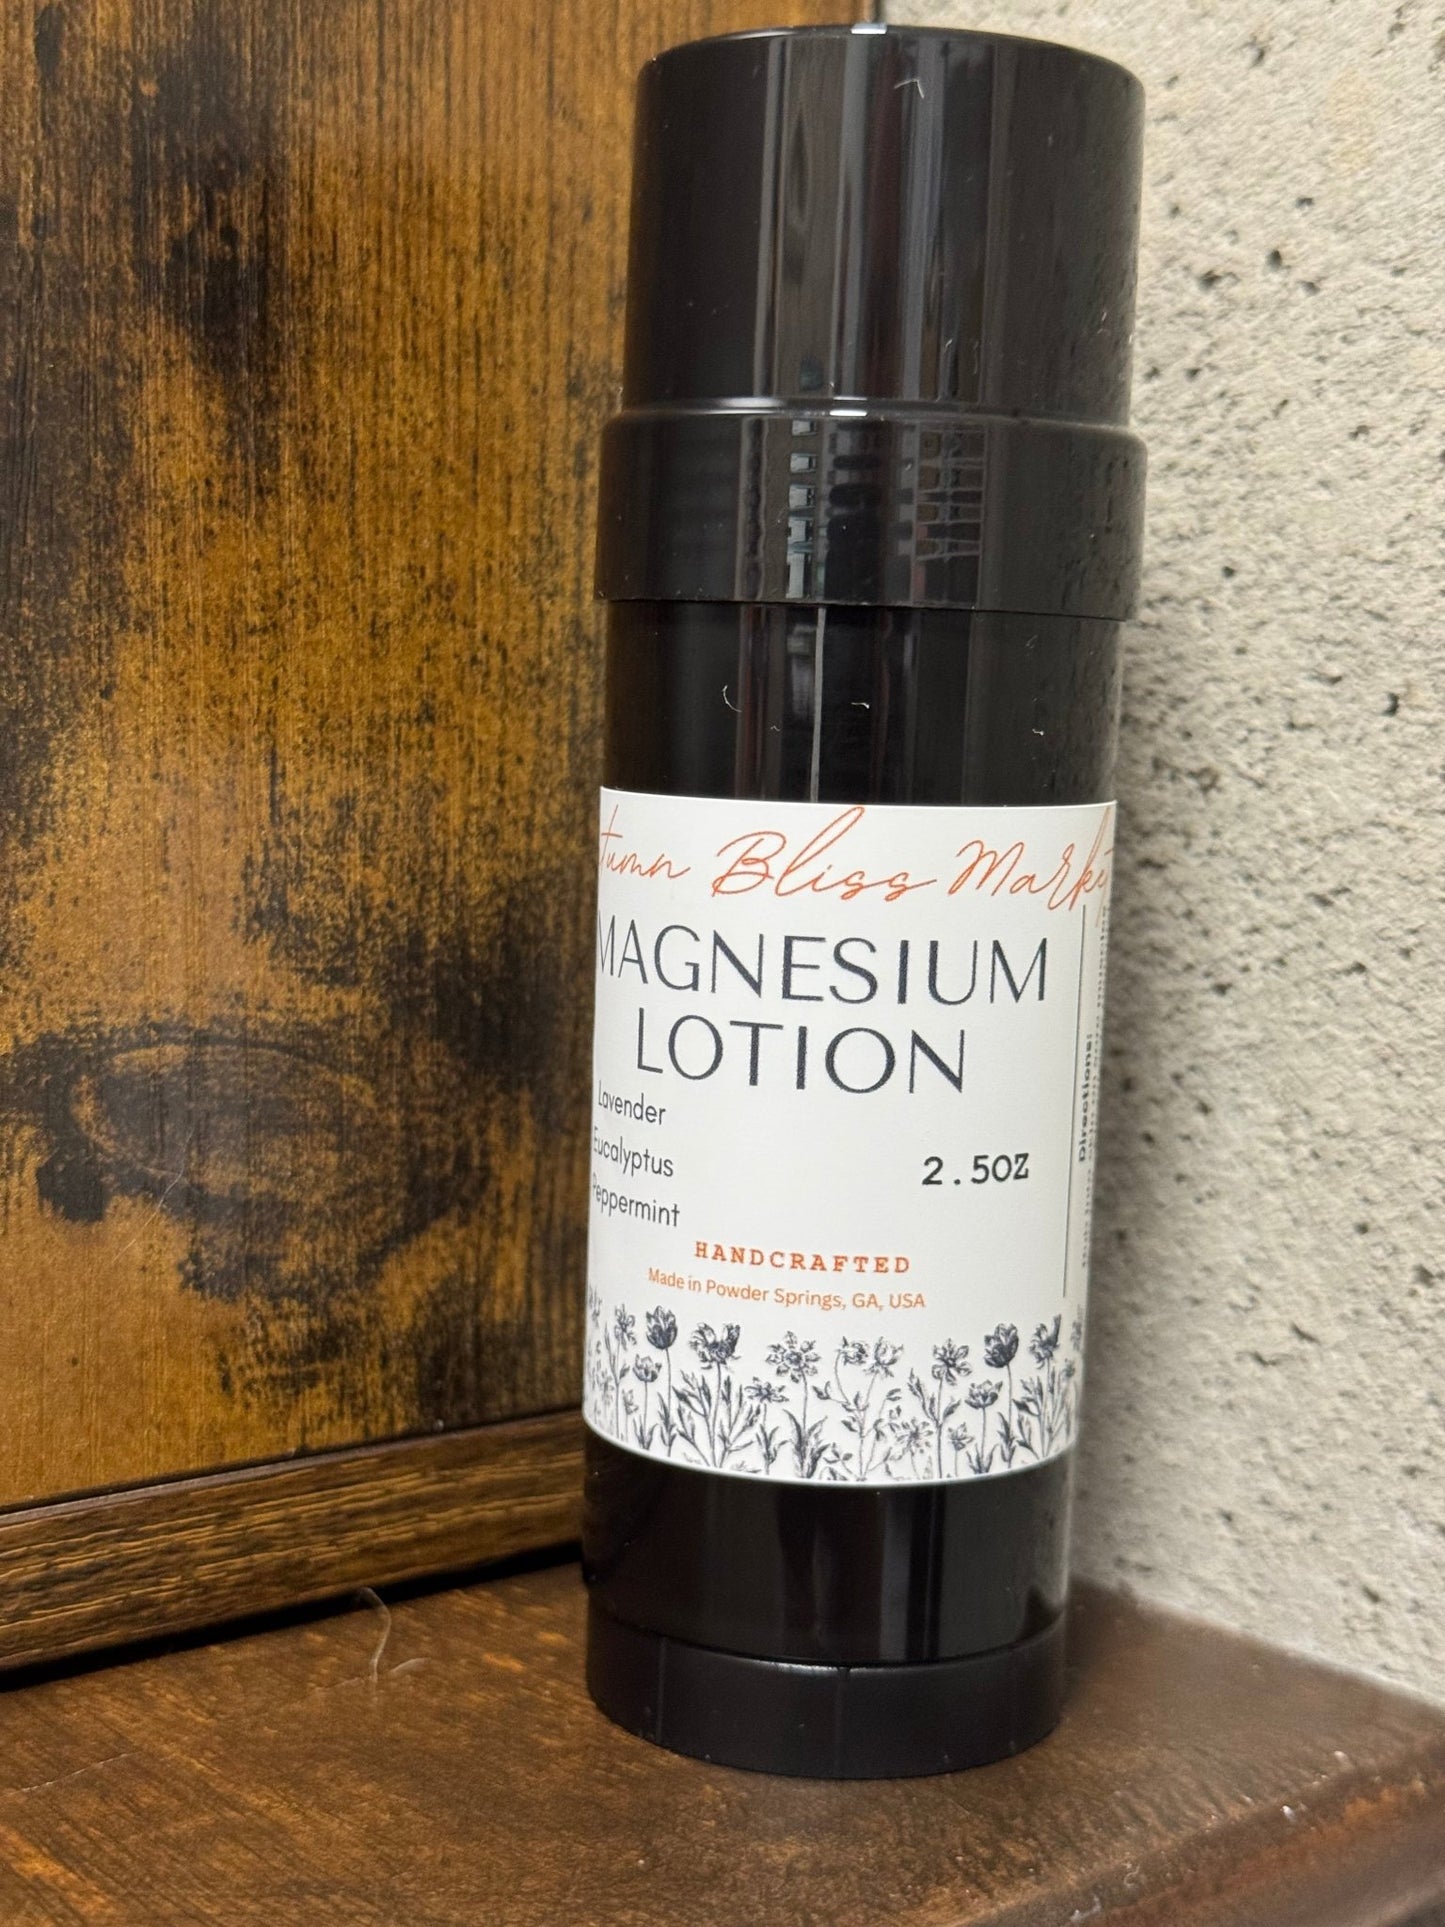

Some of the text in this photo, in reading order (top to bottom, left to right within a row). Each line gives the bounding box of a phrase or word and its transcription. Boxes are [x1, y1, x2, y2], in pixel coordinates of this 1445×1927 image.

[711, 805, 938, 902] Bliss
[597, 911, 1048, 1006] MAGNESIUM
[637, 1007, 965, 1094] LOTION
[598, 1080, 666, 1125] Lavender
[593, 1126, 674, 1177] Eucalyptus
[921, 1152, 1029, 1185] 2.5OZ
[592, 1172, 680, 1227] Peppermint
[694, 1240, 910, 1274] HANDCRAFTED
[648, 1266, 927, 1312] Made in Powder Springs, GA, USA
